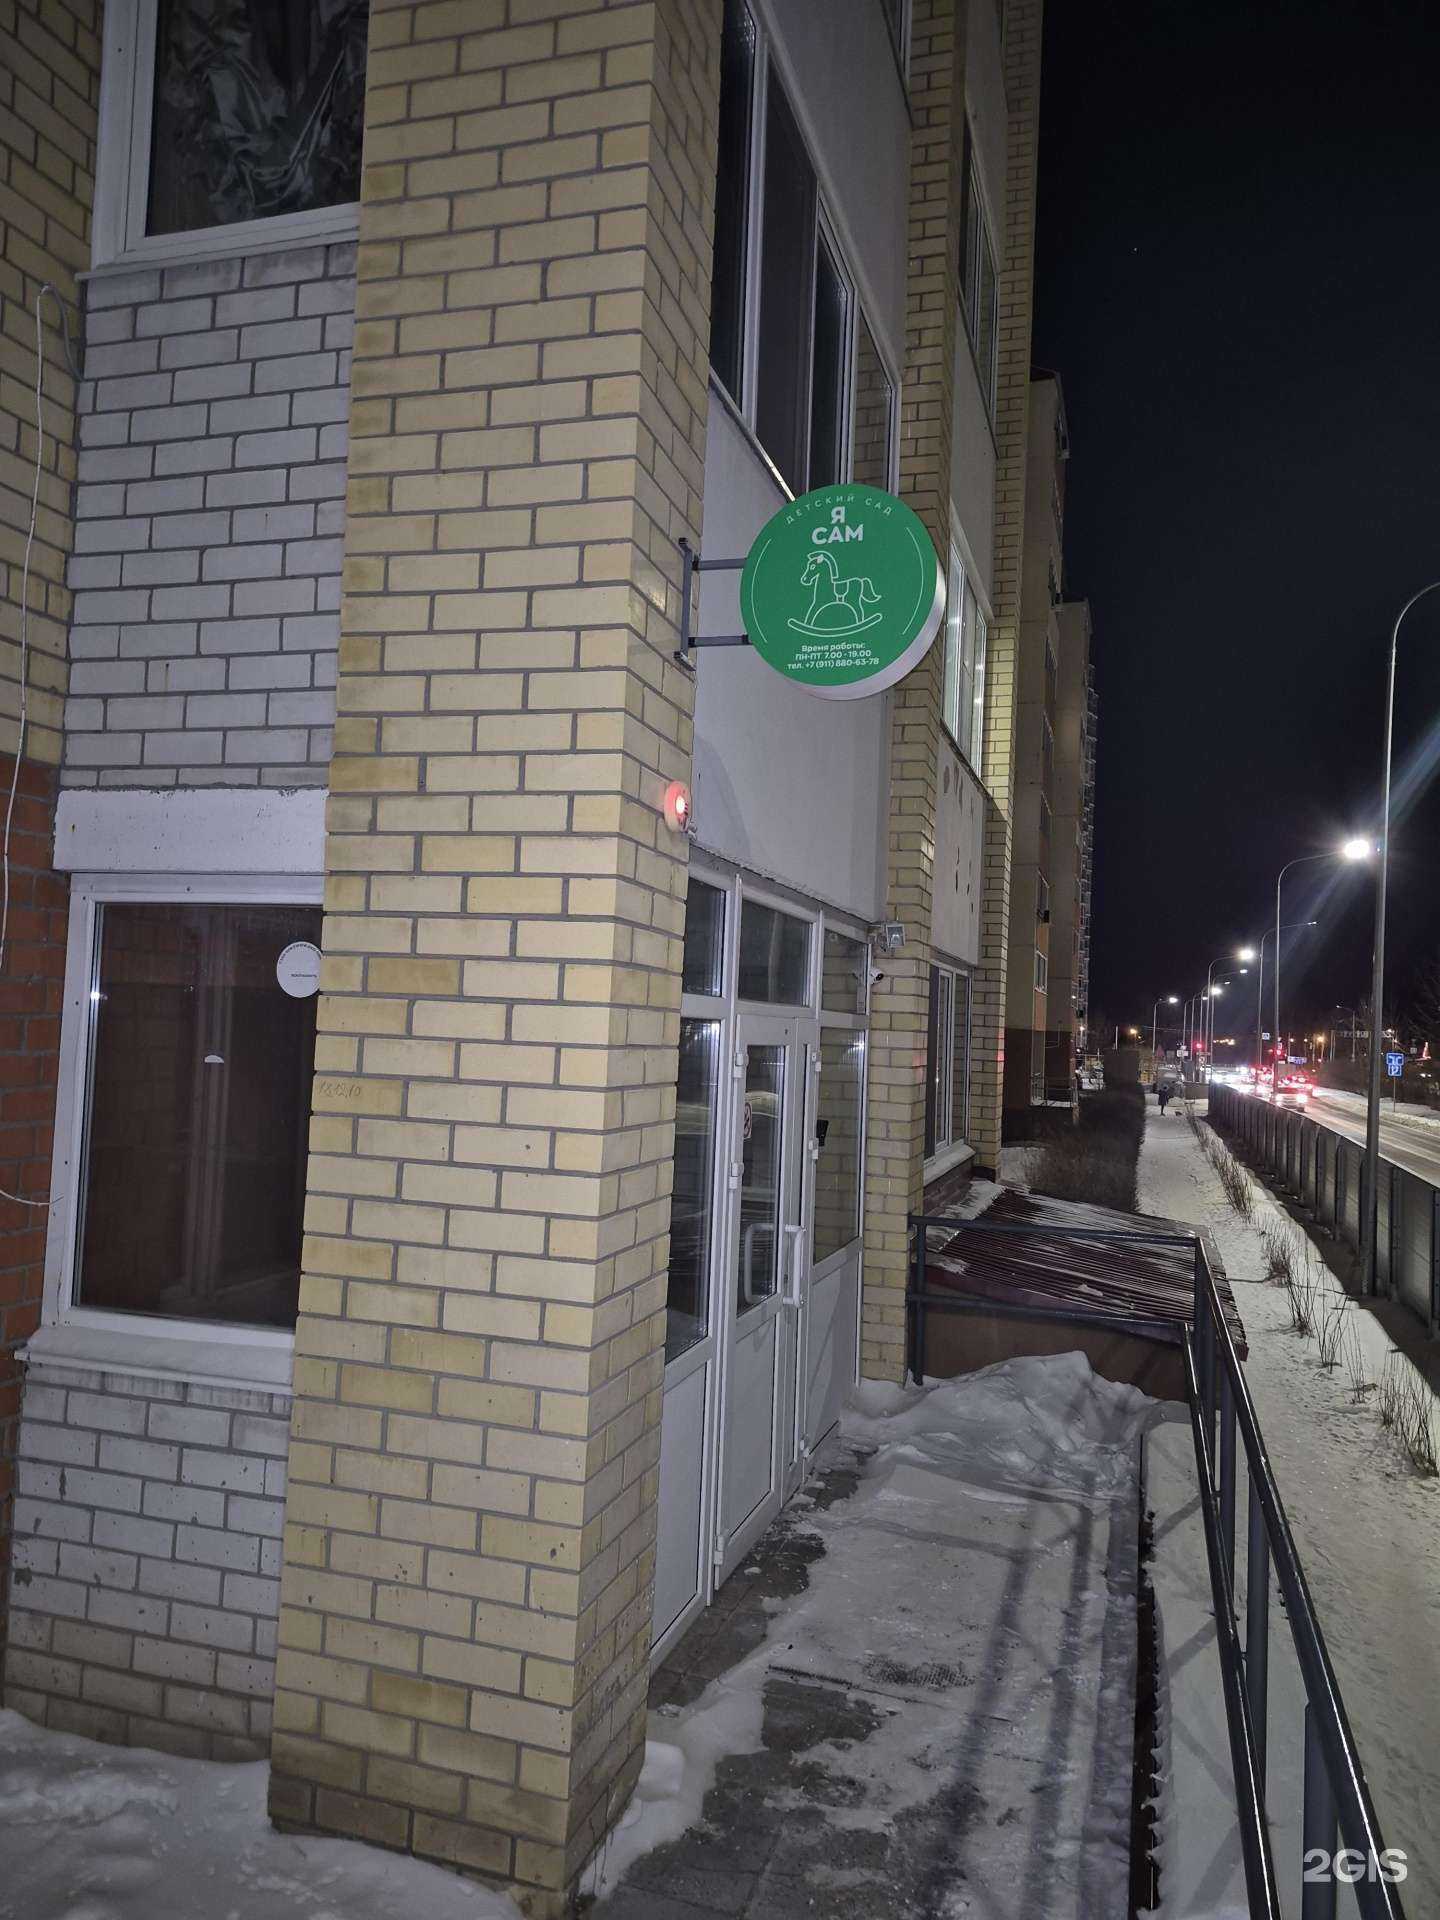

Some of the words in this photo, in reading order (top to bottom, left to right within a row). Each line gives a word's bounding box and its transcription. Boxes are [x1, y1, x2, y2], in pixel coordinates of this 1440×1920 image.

[786, 494, 854, 524] ДЕТСКИЙ
[865, 498, 892, 516] САД
[831, 506, 845, 524] Я
[811, 524, 864, 544] САМ
[795, 653, 822, 661] ПН-ПТ
[824, 652, 842, 660] 7.00
[801, 645, 829, 653] Время
